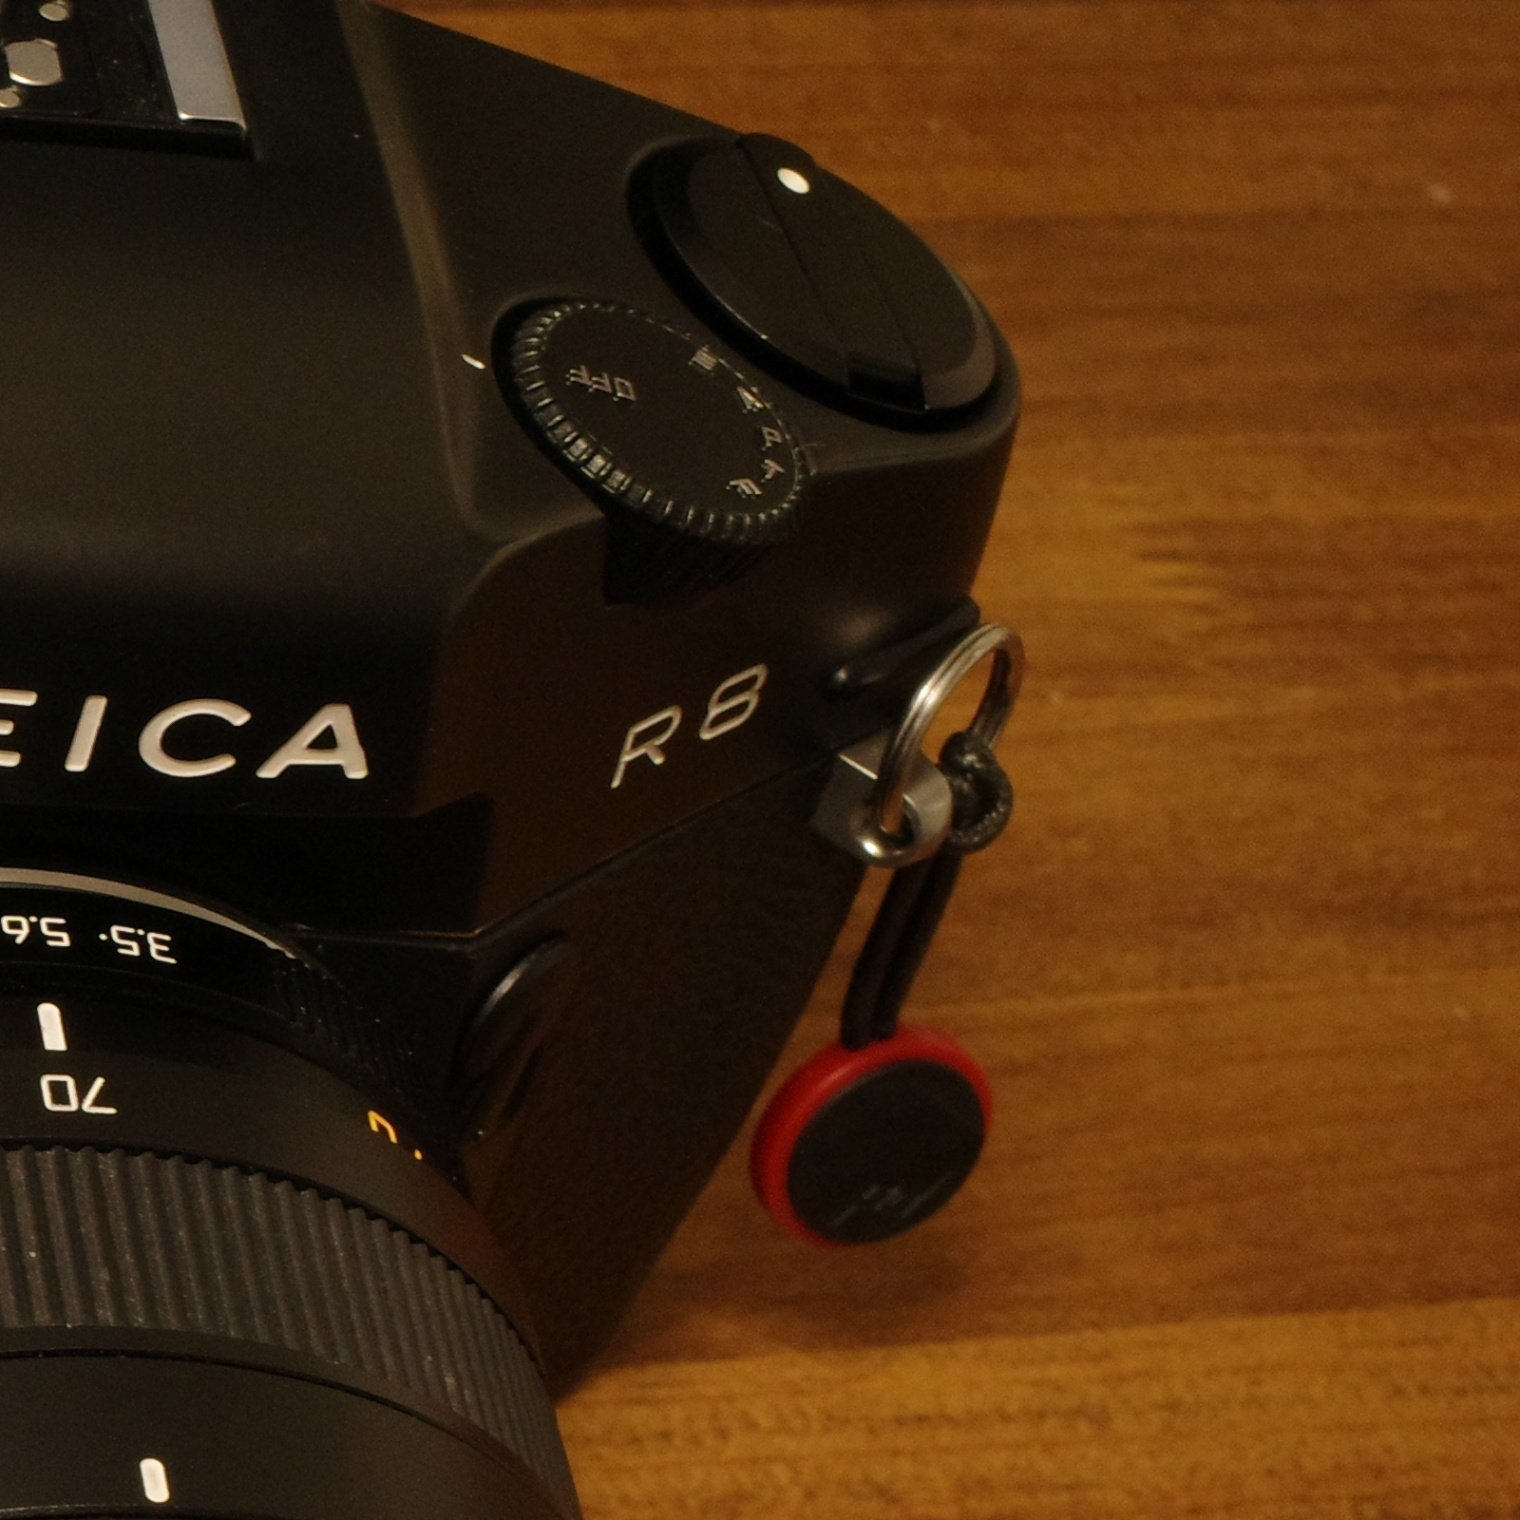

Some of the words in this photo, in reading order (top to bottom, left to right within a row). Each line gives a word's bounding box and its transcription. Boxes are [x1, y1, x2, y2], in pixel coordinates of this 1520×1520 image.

[566, 364, 636, 401] OFF
[1, 914, 72, 948] 5.6
[110, 923, 178, 965] 3.5
[40, 1074, 118, 1115] 70
